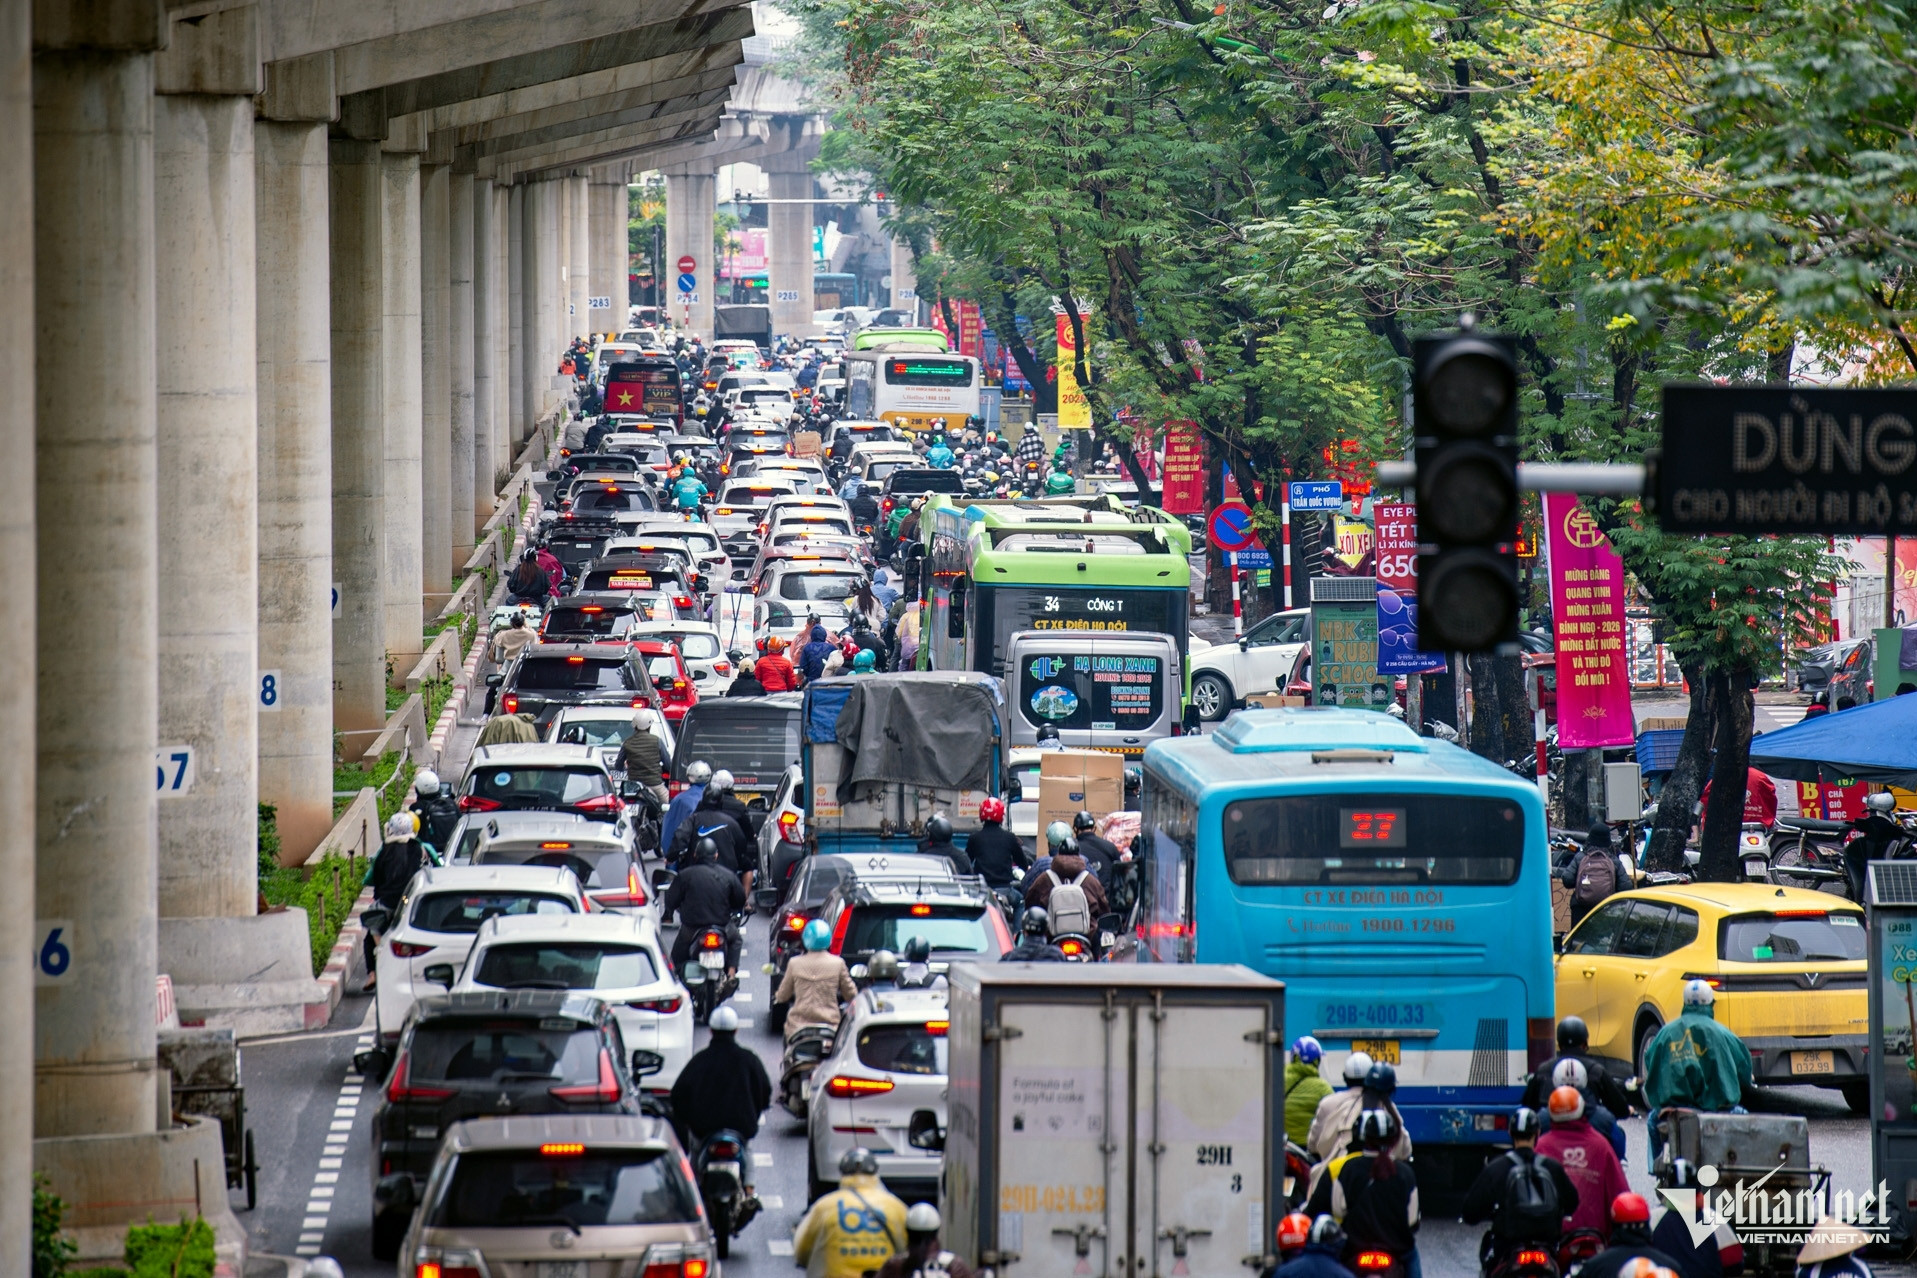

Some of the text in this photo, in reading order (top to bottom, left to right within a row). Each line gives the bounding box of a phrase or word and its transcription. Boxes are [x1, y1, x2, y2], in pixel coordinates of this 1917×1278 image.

[778, 291, 798, 300] P285
[900, 290, 913, 299] P28
[1733, 394, 1916, 474] DỪNG
[1312, 485, 1331, 493] PHỐ
[1293, 496, 1341, 508] TRẦN QUỐC VƯỢNG
[1672, 487, 1729, 523] CHO
[1736, 480, 1818, 524] NGƯỜI
[1383, 508, 1419, 517] EYE PL
[1379, 521, 1407, 538] TẾT
[1339, 531, 1355, 555] XÔI
[1379, 540, 1388, 549] LÌ
[1389, 540, 1398, 549] XÌ
[1565, 565, 1610, 581] MỪNG ĐẢNG
[1566, 586, 1611, 600] QUANG VINH
[1044, 596, 1123, 611] 34 CÔNG T
[1566, 601, 1612, 616] MỪNG XUÂN
[1034, 621, 1050, 630] CT
[1051, 621, 1063, 629] XE
[1320, 621, 1356, 640] NBK
[1559, 620, 1578, 634] BÍNH
[1580, 622, 1596, 636] NGỌ
[1602, 621, 1620, 632] 2026
[1560, 635, 1621, 652] MỪNG ĐẤT NƯỚC
[1334, 642, 1377, 662] RUBI
[1074, 656, 1157, 673] HẠ LONG XANH
[1572, 652, 1611, 669] VÀ THỦ ĐÔ
[1094, 673, 1121, 682] HOTLINE:
[1122, 673, 1136, 682] 1900
[1590, 671, 1605, 685] MỚI
[260, 674, 277, 706] 8
[1828, 788, 1844, 798] CHẢ
[1829, 799, 1842, 808] GIÒ
[1830, 811, 1847, 820] MỌC
[1352, 813, 1396, 839] 27
[1304, 887, 1443, 908] CT XE ĐIỆN HÀ NỘI
[1303, 919, 1455, 933] Hotline 1900.1296
[35, 928, 71, 977] 6
[1893, 945, 1917, 961] Xe
[1326, 1004, 1425, 1025] 29B-400.33
[1803, 1052, 1821, 1062] 29K
[1797, 1062, 1830, 1072] 032.99
[1013, 1077, 1075, 1090] Formula of
[1023, 1090, 1055, 1104] joyful
[1196, 1146, 1233, 1165] 29H
[1231, 1173, 1242, 1194] 3
[837, 1199, 887, 1234] be
